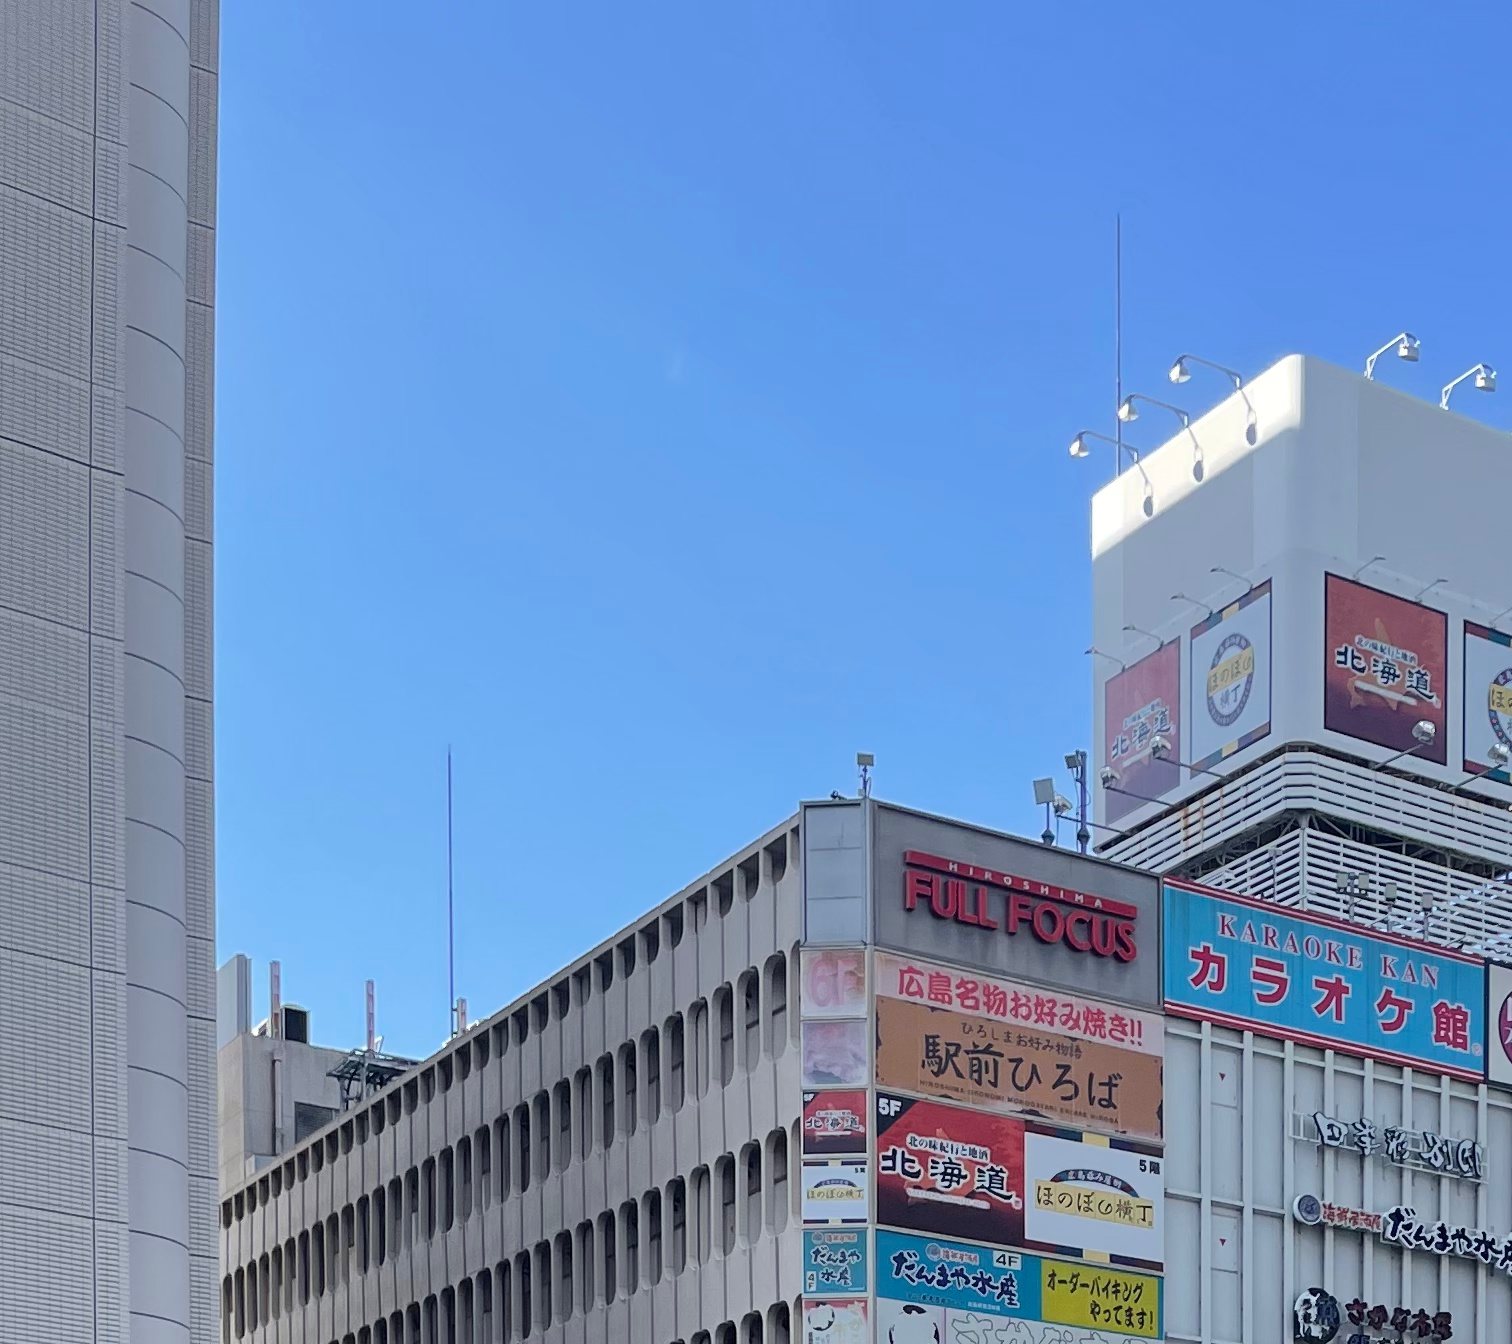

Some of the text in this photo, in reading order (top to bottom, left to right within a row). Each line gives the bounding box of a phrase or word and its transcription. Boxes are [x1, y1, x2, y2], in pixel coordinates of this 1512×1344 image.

[1336, 646, 1433, 700] 北海道
[1112, 708, 1171, 759] 北海道
[949, 862, 1104, 908] HIROSHIMA
[904, 870, 1138, 962] FULL FOCUS
[1217, 913, 1439, 990] KARAOKE KAN
[1189, 943, 1472, 1052] カラオケ館
[921, 1034, 1123, 1110] 駅前ひろば
[806, 1117, 860, 1131] 北海道
[878, 1098, 901, 1117] 5F
[881, 1148, 1013, 1200] 北海道
[811, 1246, 861, 1264] だんまや
[996, 1253, 1019, 1267] 4F
[893, 1252, 1020, 1307] だんまや水産
[1048, 1270, 1144, 1303] オーダーバイキング
[1090, 1303, 1154, 1331] やってます!
[1345, 1298, 1452, 1340] さかな市場
